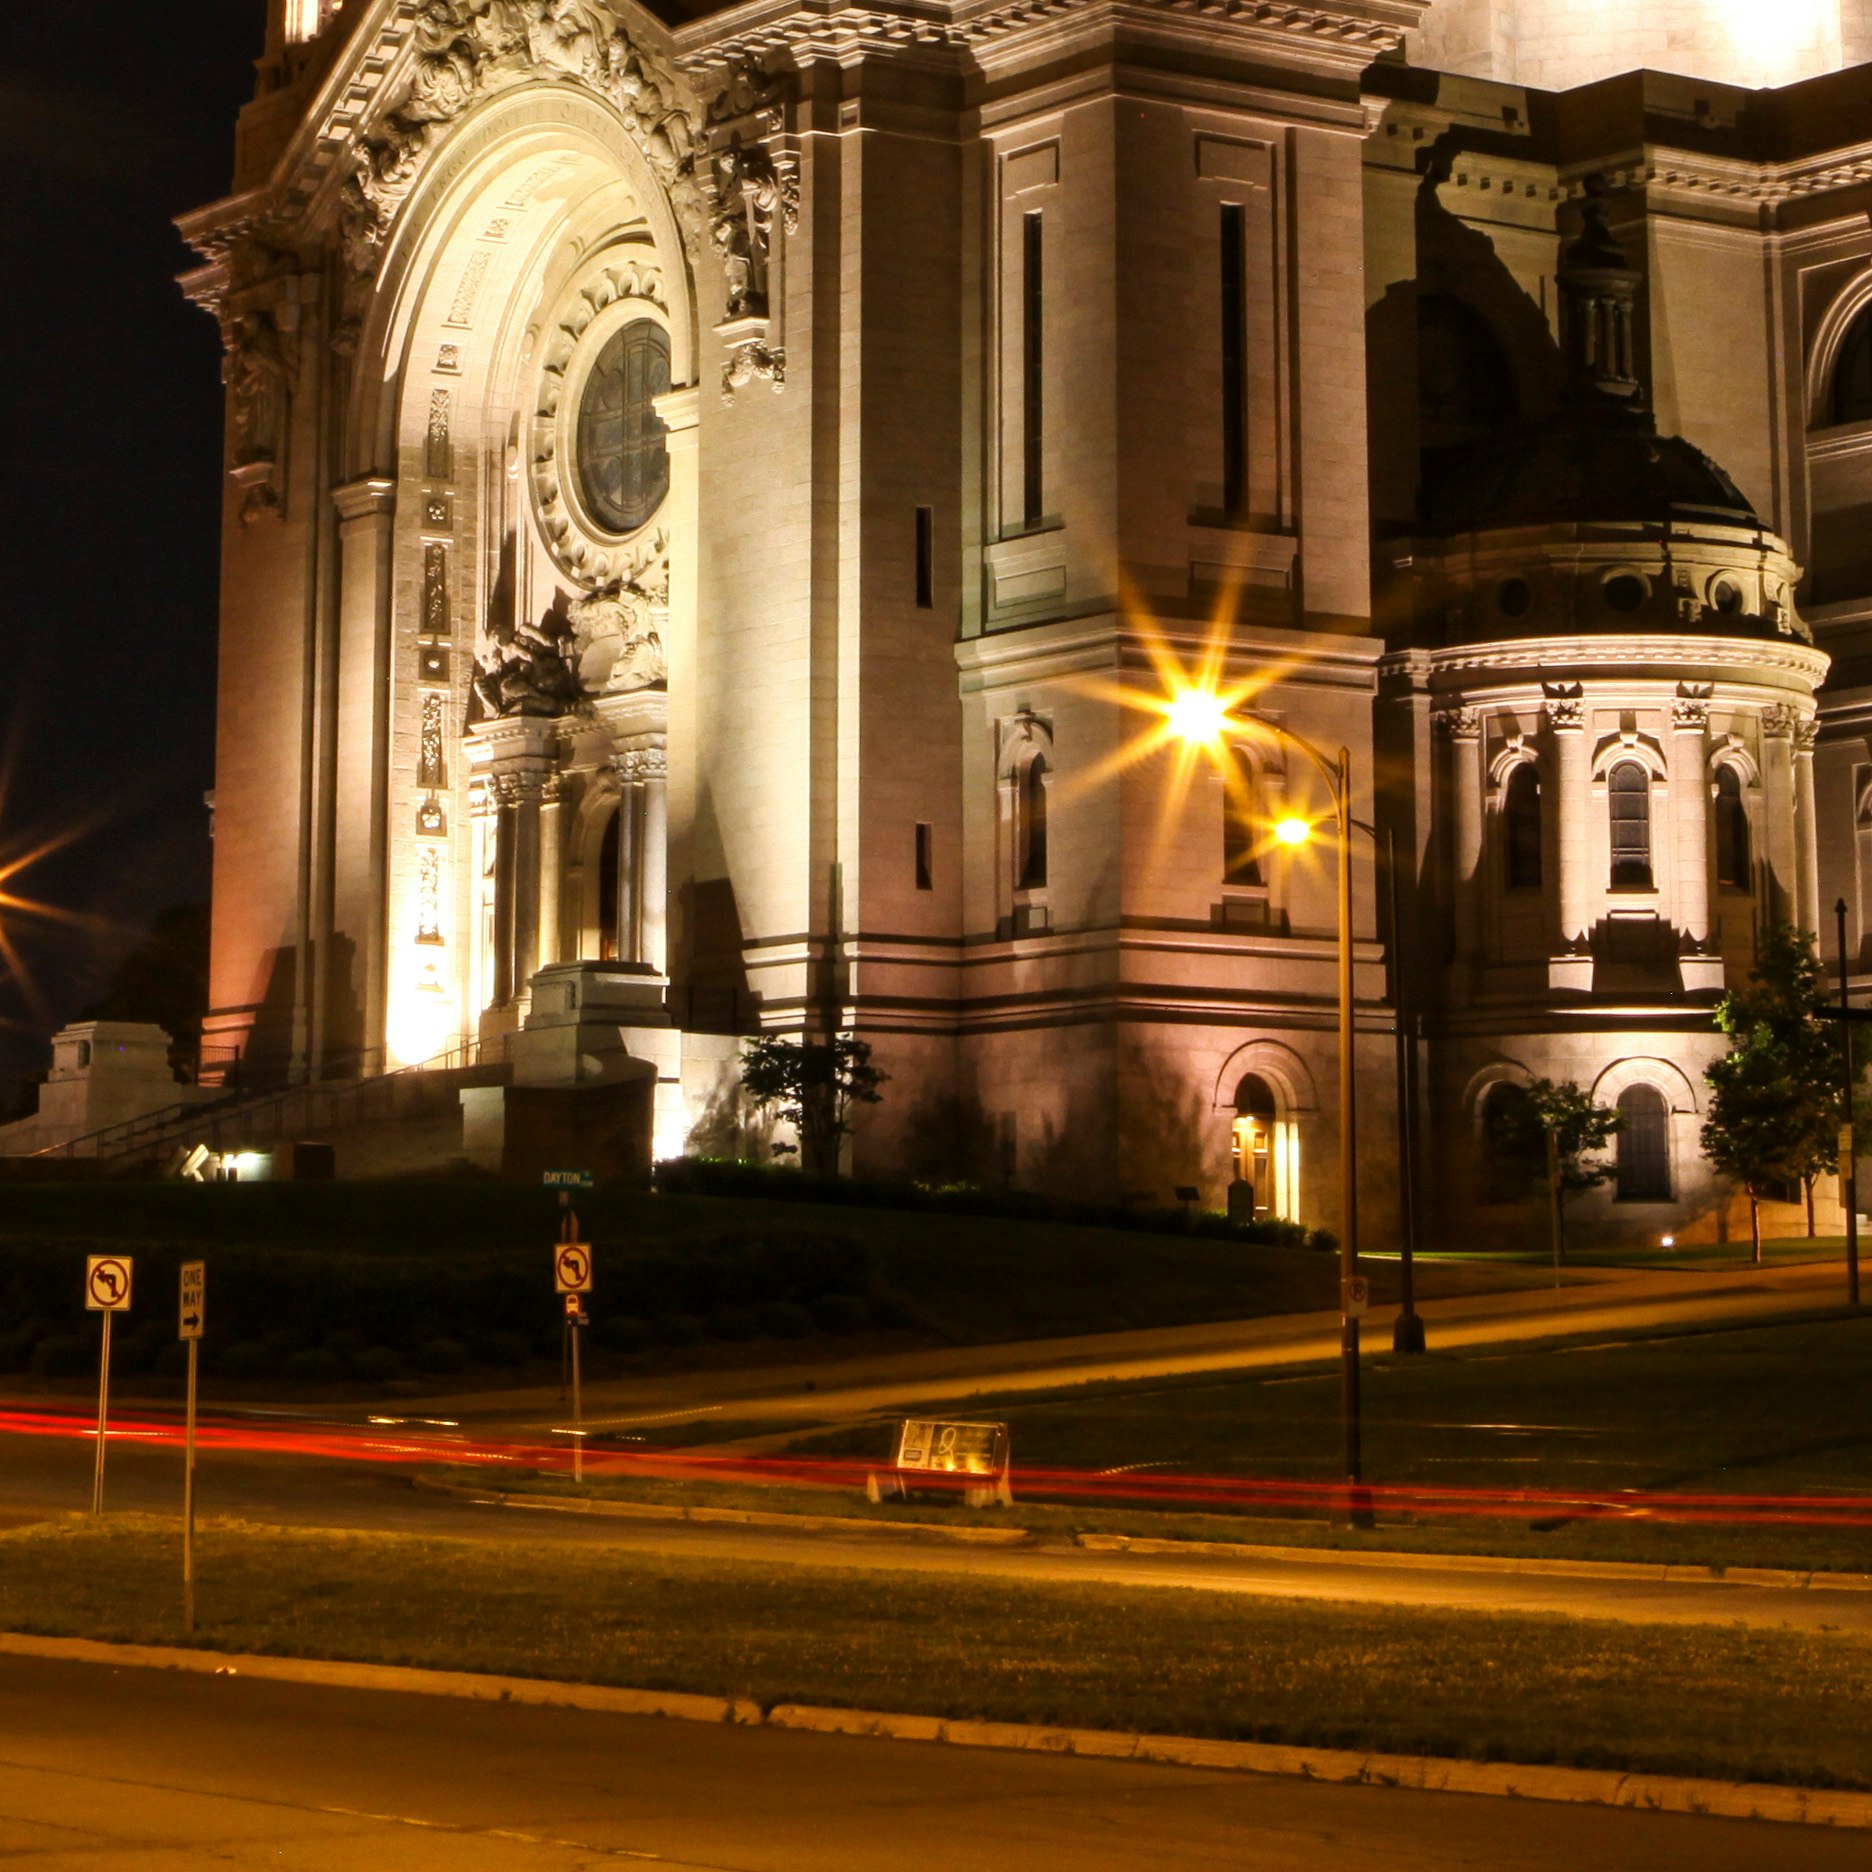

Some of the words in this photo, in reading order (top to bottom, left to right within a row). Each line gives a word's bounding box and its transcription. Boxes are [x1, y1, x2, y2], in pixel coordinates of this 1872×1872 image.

[544, 1172, 580, 1185] DAYTON
[183, 1268, 202, 1288] ONE
[183, 1290, 202, 1309] WAY
